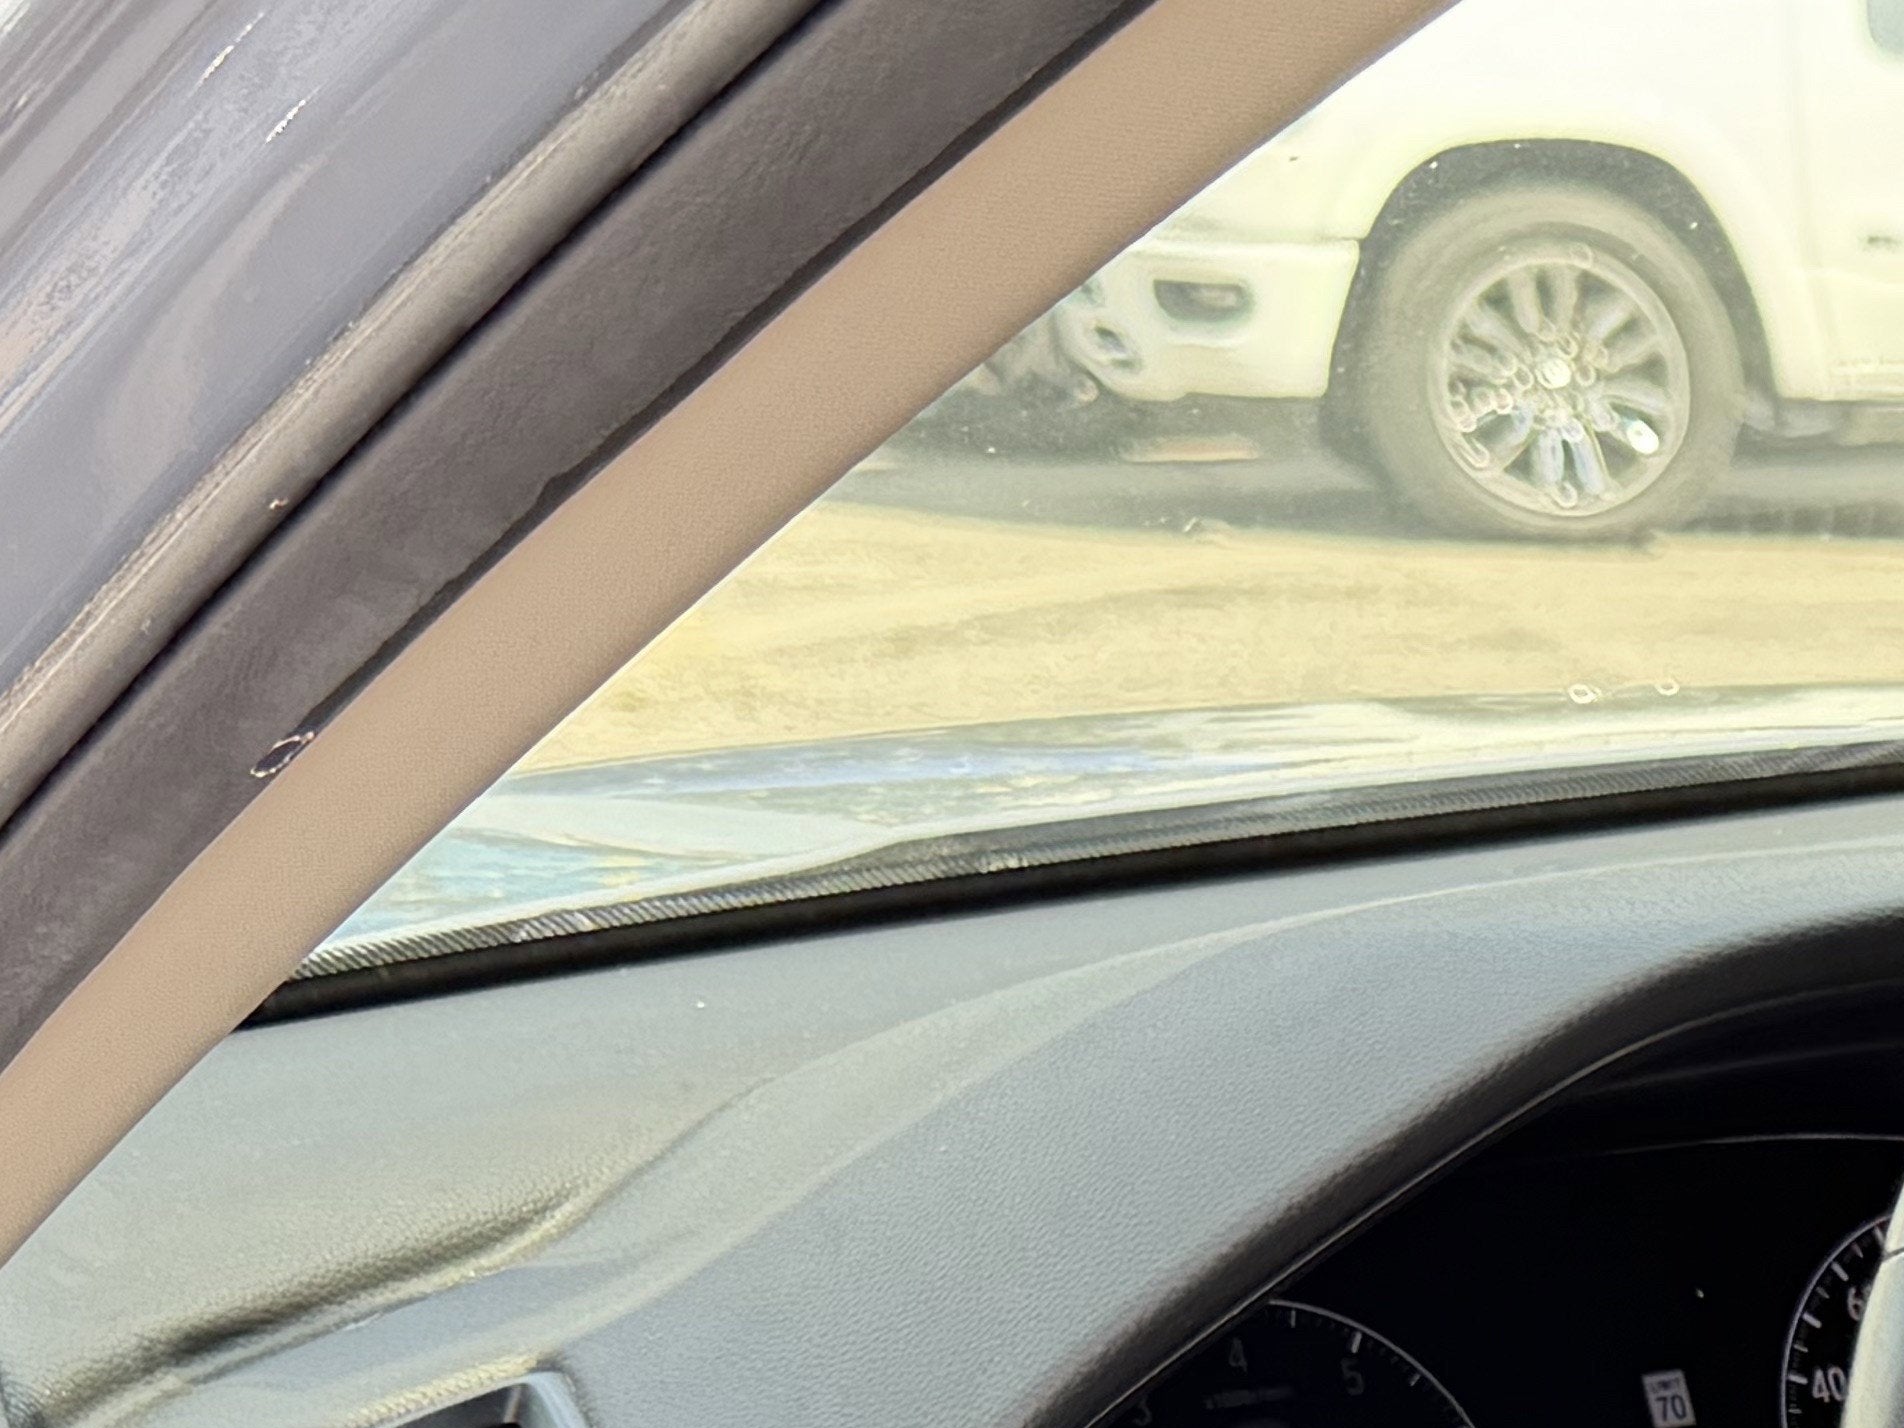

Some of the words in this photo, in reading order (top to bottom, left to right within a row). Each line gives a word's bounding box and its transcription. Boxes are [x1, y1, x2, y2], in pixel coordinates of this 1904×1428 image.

[1227, 1336, 1248, 1373] 4
[1340, 1356, 1364, 1396] 5
[1812, 1366, 1848, 1404] 40
[1655, 1394, 1688, 1423] 70
